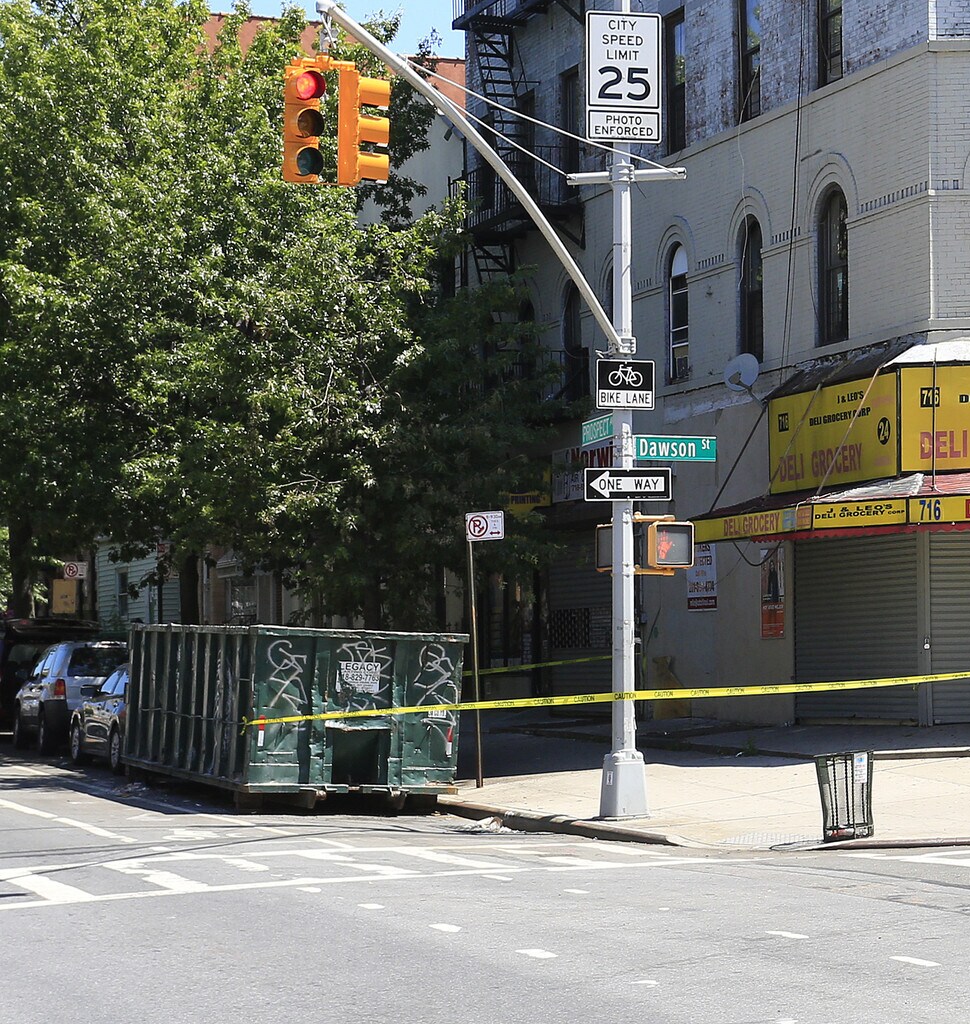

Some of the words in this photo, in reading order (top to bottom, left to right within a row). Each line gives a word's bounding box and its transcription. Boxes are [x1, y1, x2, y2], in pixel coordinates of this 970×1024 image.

[608, 19, 637, 31] CITY
[602, 34, 644, 46] SPEED
[606, 49, 640, 61] LIMIT
[598, 66, 651, 101] 25
[606, 115, 642, 126] PHOTO
[595, 126, 653, 137] ENFORCED
[601, 392, 621, 403] BIKE
[626, 392, 650, 404] LANE
[841, 394, 847, 403] &
[847, 390, 865, 402] LEO'S
[921, 389, 940, 407] 716
[809, 416, 822, 426] DELI
[823, 410, 852, 424] GROCERY
[583, 417, 609, 443] PROSPECT
[878, 418, 890, 443] 24
[640, 439, 696, 457] Dawson
[701, 439, 710, 450] St
[920, 430, 967, 459] DELI
[779, 454, 804, 483] DELI
[811, 443, 862, 477] GROCERY
[599, 479, 622, 490] ONE
[634, 479, 660, 490] WAY
[815, 512, 836, 520] DELI
[839, 510, 884, 518] GROCERY
[856, 503, 893, 512] LEO'S
[919, 500, 941, 520] 716
[723, 517, 741, 537] DELI
[742, 512, 780, 534] GROCERY
[533, 697, 554, 705] CAUTION
[573, 695, 595, 703] CAUTION
[614, 692, 637, 701] CAUTION
[654, 690, 674, 698] CAUTION
